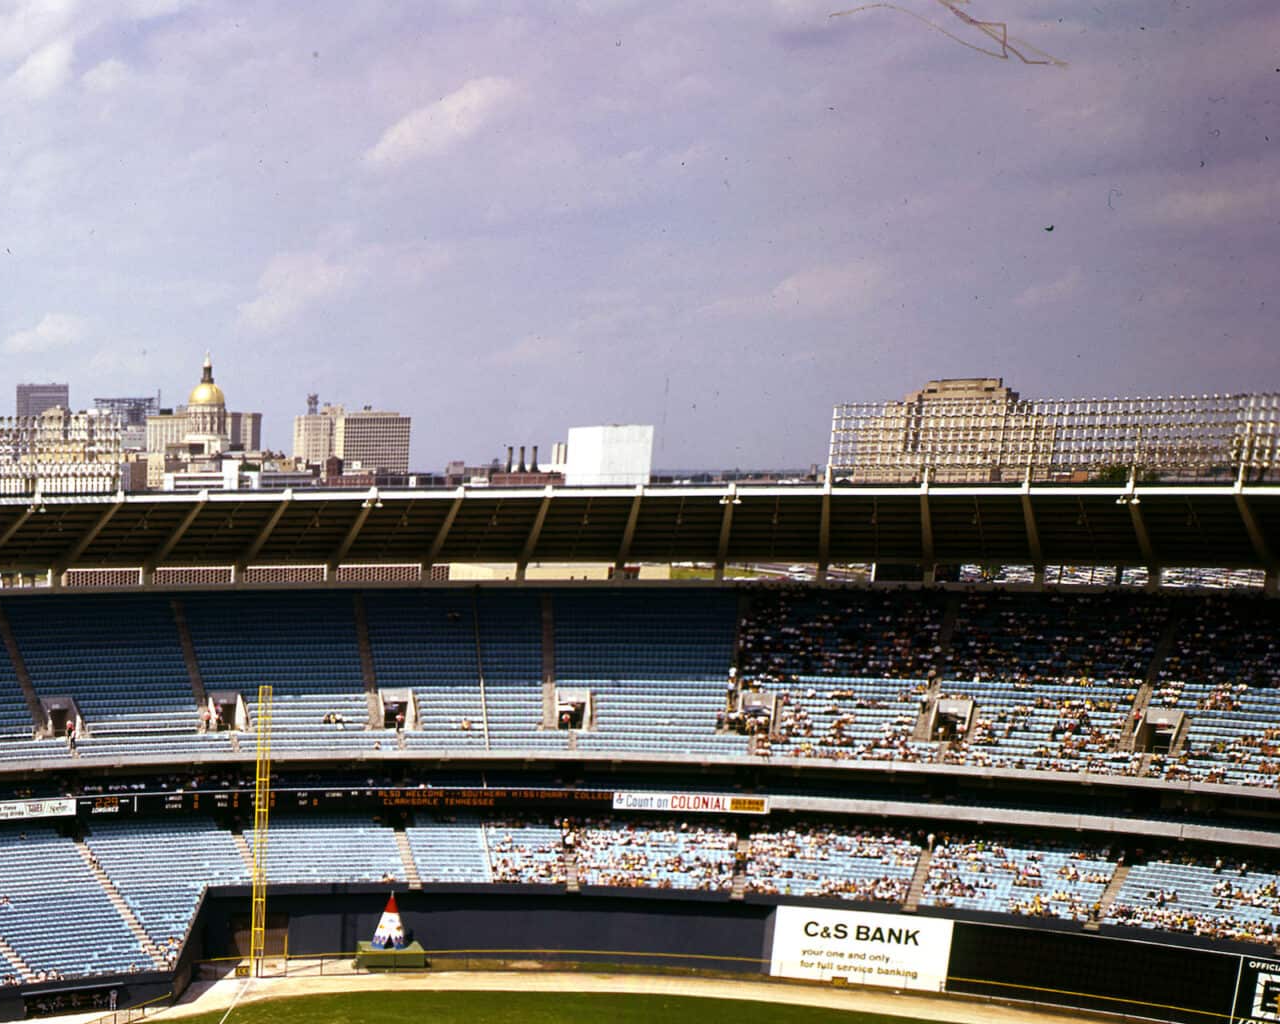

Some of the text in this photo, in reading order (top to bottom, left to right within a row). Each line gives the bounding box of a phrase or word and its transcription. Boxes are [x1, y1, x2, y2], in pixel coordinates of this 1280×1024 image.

[625, 794, 726, 811] Count on COLONIAL
[804, 921, 920, 946] C&S BANK
[801, 948, 824, 957] your
[826, 950, 845, 958] one
[847, 951, 867, 961] and
[799, 959, 919, 980] for full service banking
